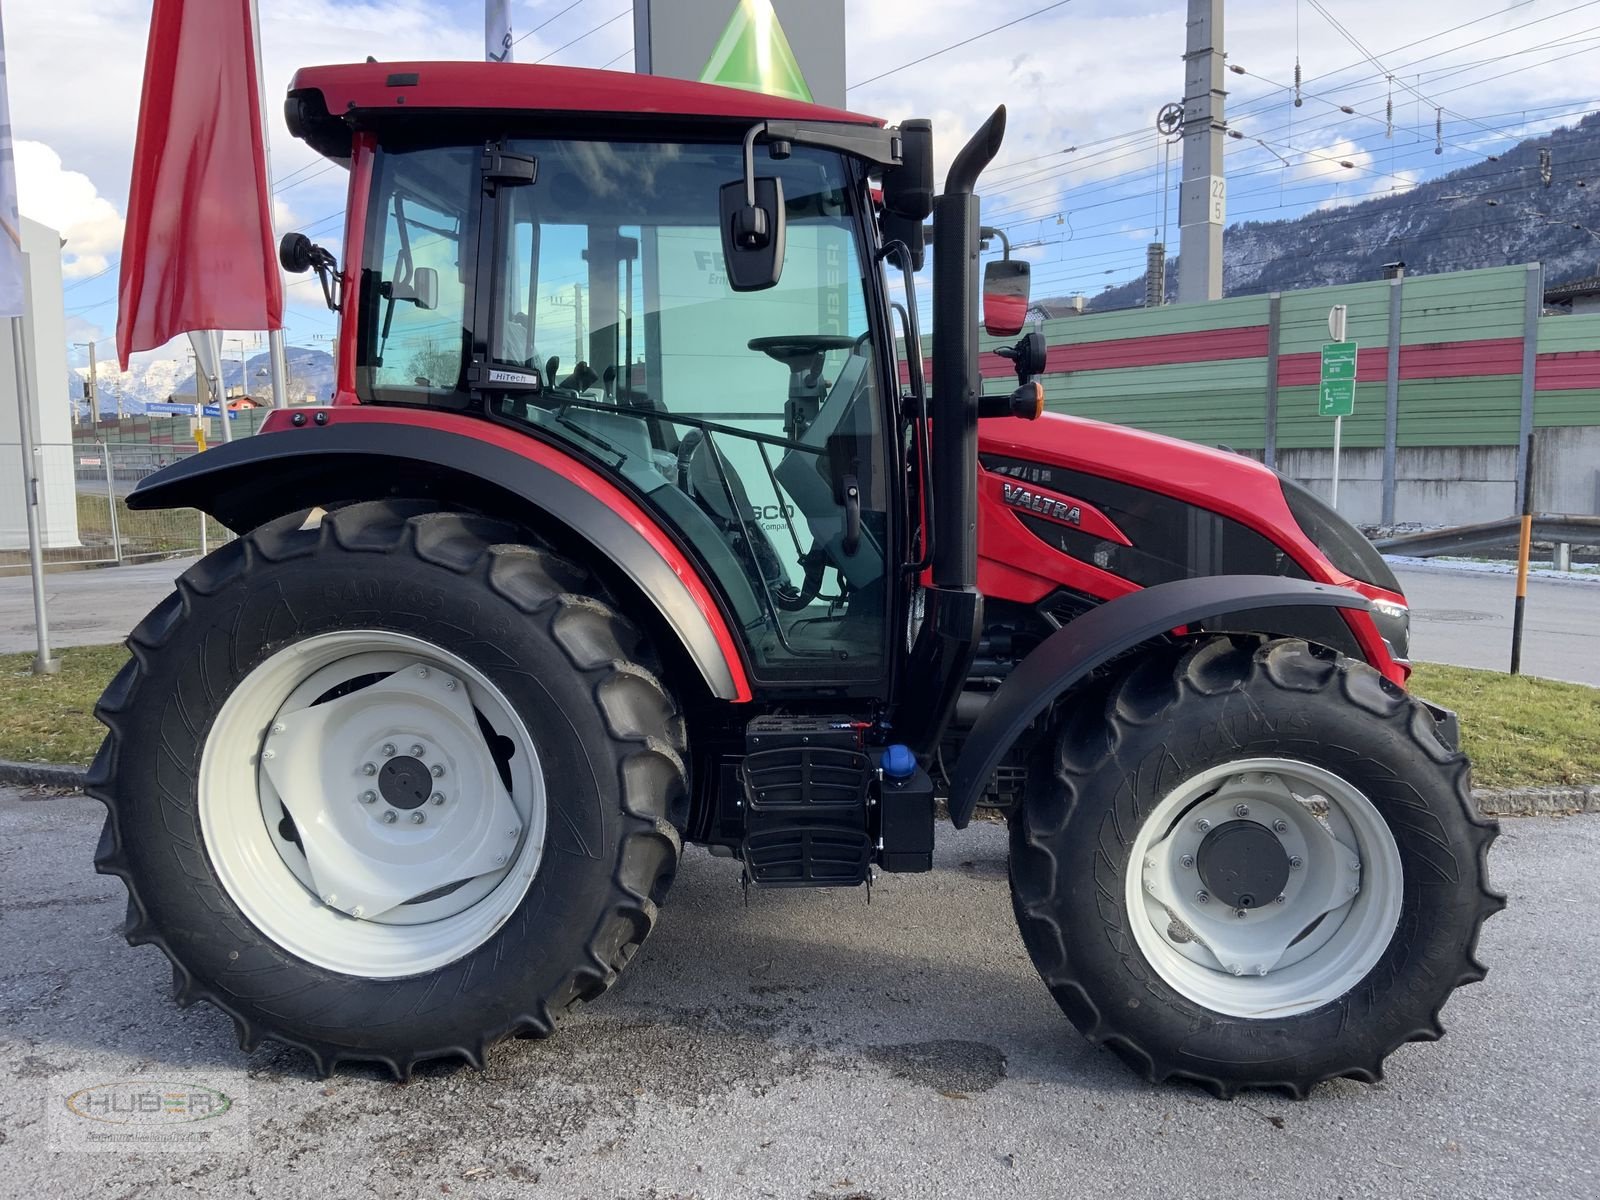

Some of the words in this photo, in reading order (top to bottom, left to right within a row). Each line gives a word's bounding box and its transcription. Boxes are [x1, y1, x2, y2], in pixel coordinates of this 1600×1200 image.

[1212, 180, 1225, 199] 22
[1215, 202, 1222, 219] 5
[496, 372, 526, 383] HiTech
[1003, 483, 1081, 526] VALTRA
